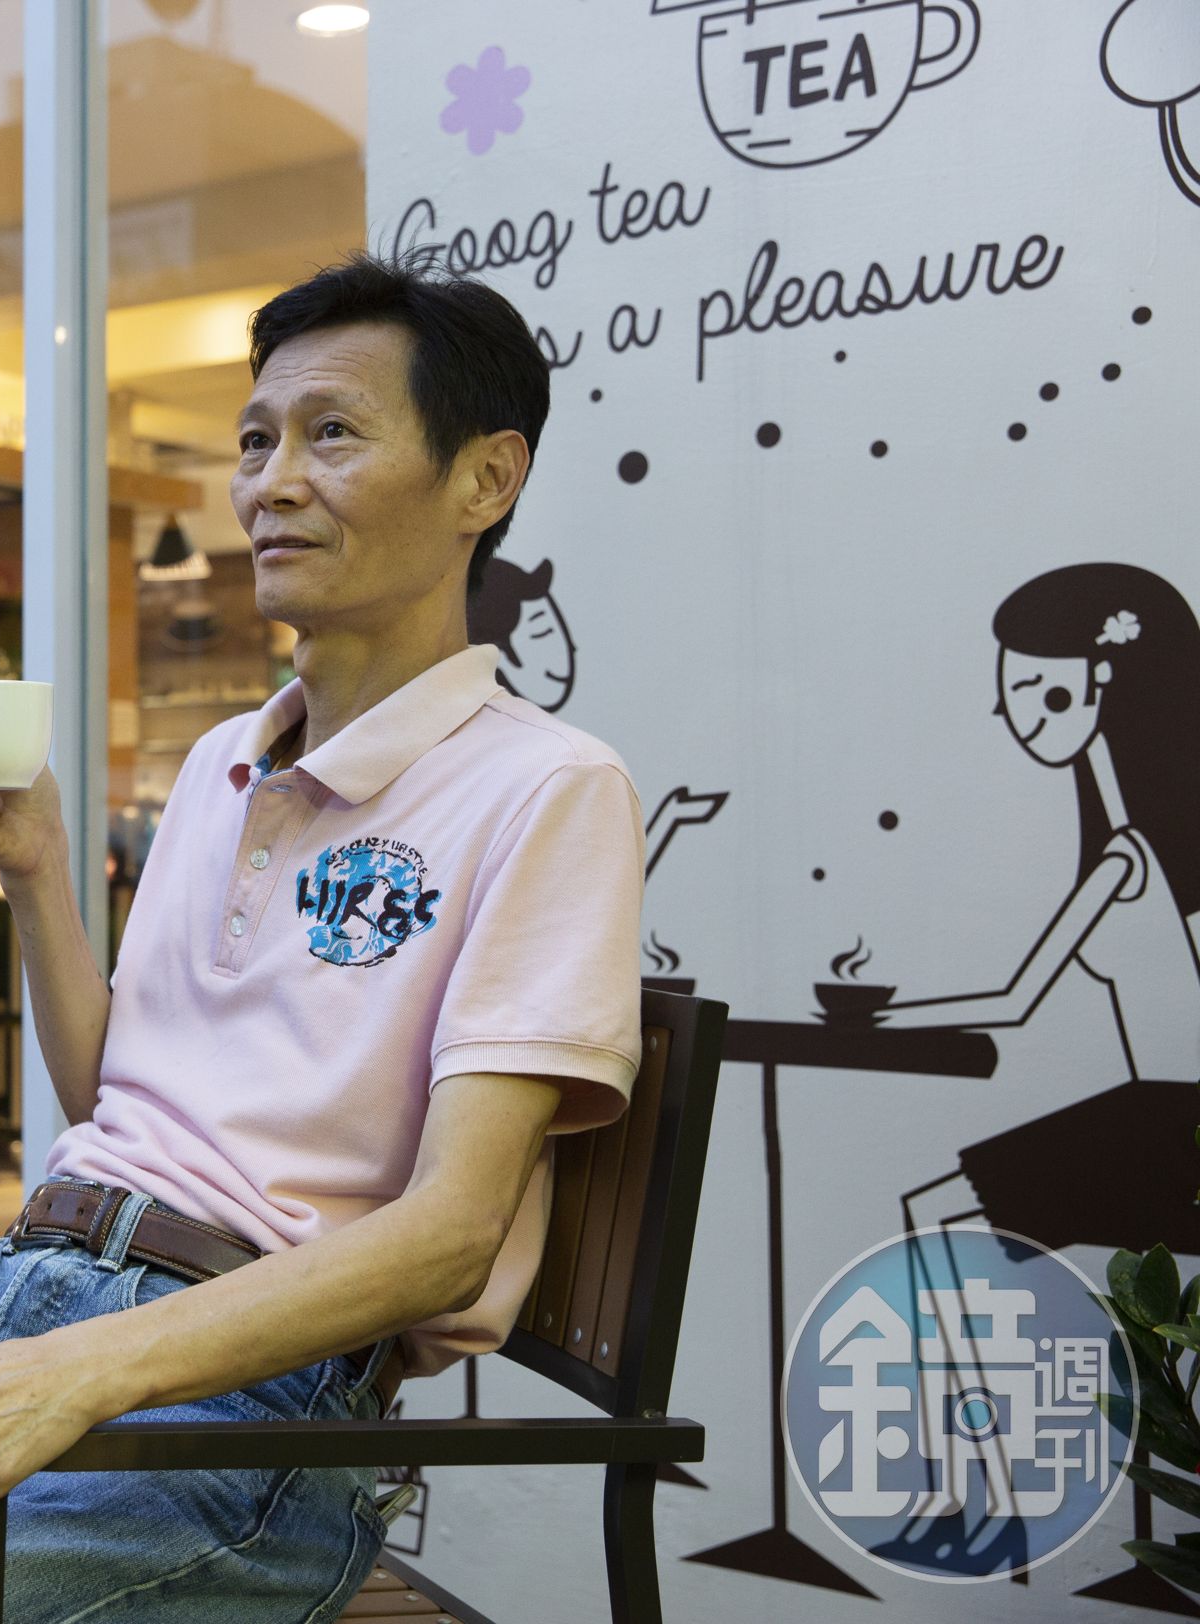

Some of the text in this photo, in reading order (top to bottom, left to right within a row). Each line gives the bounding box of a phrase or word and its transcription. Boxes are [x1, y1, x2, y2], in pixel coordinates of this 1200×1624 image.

[743, 32, 877, 116] TEA
[588, 162, 711, 244] tea
[609, 304, 661, 353] a
[697, 233, 1065, 382] pleasure
